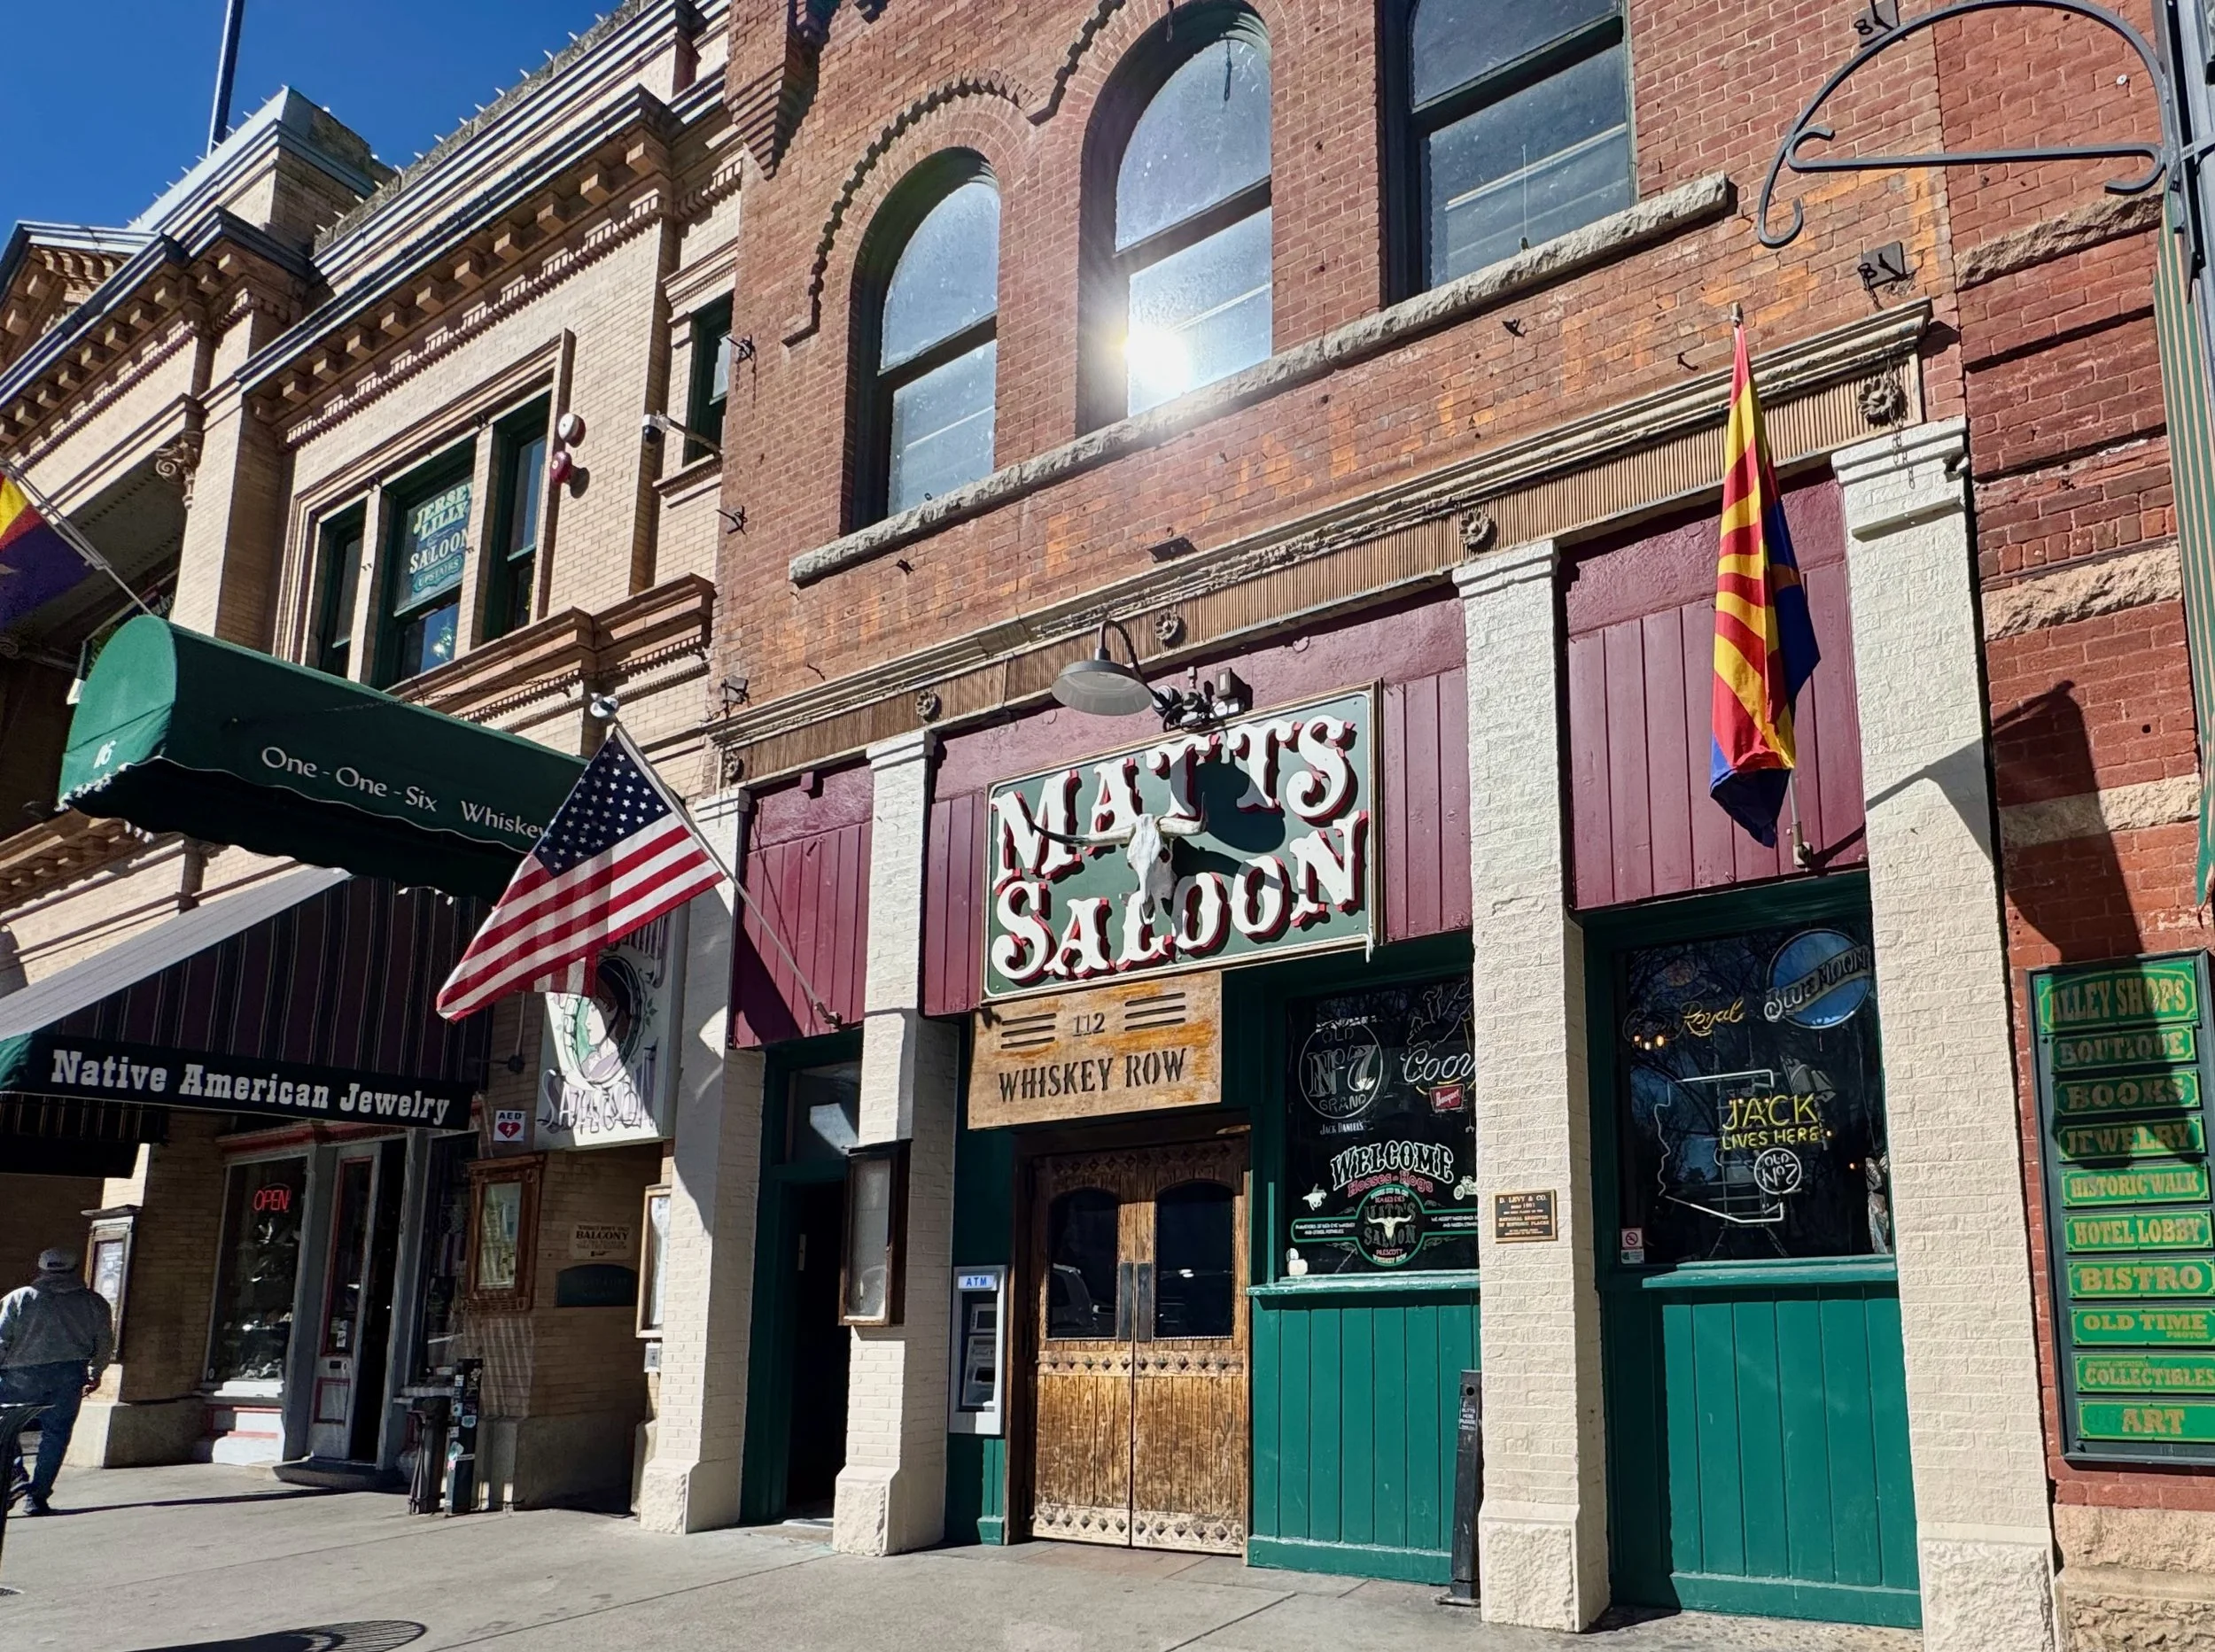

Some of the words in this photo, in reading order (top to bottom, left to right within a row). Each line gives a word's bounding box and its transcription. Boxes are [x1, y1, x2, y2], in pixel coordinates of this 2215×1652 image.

[420, 500, 469, 542] LILLY
[409, 529, 469, 575] SALOON
[992, 810, 1366, 981] SALOON
[1764, 975, 1816, 1022] BLUE
[1815, 945, 1871, 989] MOON
[2054, 980, 2110, 1021] ALLEY
[2115, 976, 2187, 1016] SHOPS
[1072, 1012, 1105, 1036] 112
[1680, 996, 1745, 1036] Royal
[2059, 1031, 2184, 1065] BOUTIQUE
[999, 1058, 1114, 1103] WHISKEY
[1125, 1048, 1187, 1088] ROW
[1403, 1048, 1477, 1083] Coor
[51, 1050, 167, 1092] Native
[178, 1064, 329, 1109] American
[339, 1083, 450, 1126] Jewelry
[2067, 1078, 2184, 1109] BOOKS
[1722, 1093, 1818, 1130] JACK
[1722, 1130, 1768, 1150] LIVES
[1774, 1126, 1821, 1144] HERE
[2067, 1124, 2190, 1154] JEWELRY
[1331, 1140, 1454, 1191] WELCOME
[1764, 1153, 1790, 1167] OLD
[2070, 1175, 2148, 1198] HISTORIC
[2151, 1172, 2199, 1194] WALK
[253, 1190, 291, 1211] OPEN
[576, 1230, 629, 1240] BALCONY
[1364, 1224, 1417, 1247] SALOON
[2073, 1220, 2134, 1245] HOTEL
[2136, 1218, 2202, 1243] LOBBY
[967, 1277, 987, 1287] ATM
[2079, 1266, 2202, 1291] BISTRO
[2083, 1315, 2135, 1330] OLD
[2140, 1315, 2208, 1330] TIME
[2085, 1367, 2215, 1385] COLLECTIBLES
[2122, 1408, 2185, 1433] ART
